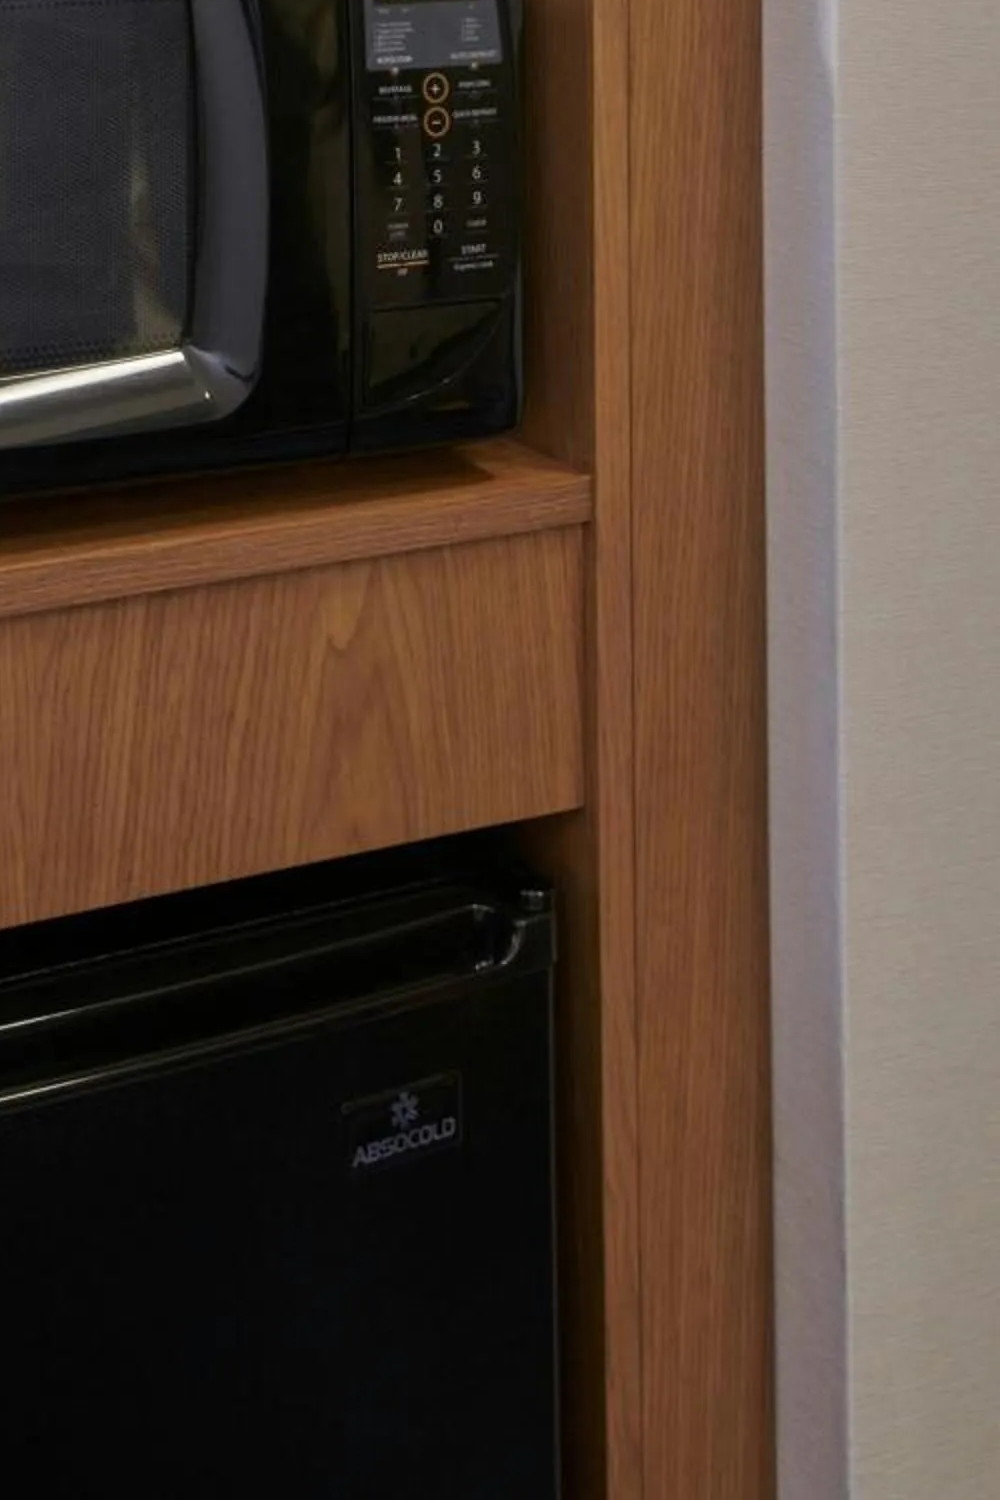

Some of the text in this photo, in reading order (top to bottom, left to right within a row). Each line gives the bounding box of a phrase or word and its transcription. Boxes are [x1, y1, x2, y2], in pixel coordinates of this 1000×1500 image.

[433, 143, 441, 157] 2
[472, 140, 481, 155] 3
[393, 165, 481, 185] 4 5 6
[394, 190, 481, 211] 7 8 9
[433, 220, 443, 234] 0
[352, 1117, 456, 1168] ABSOCOLD
